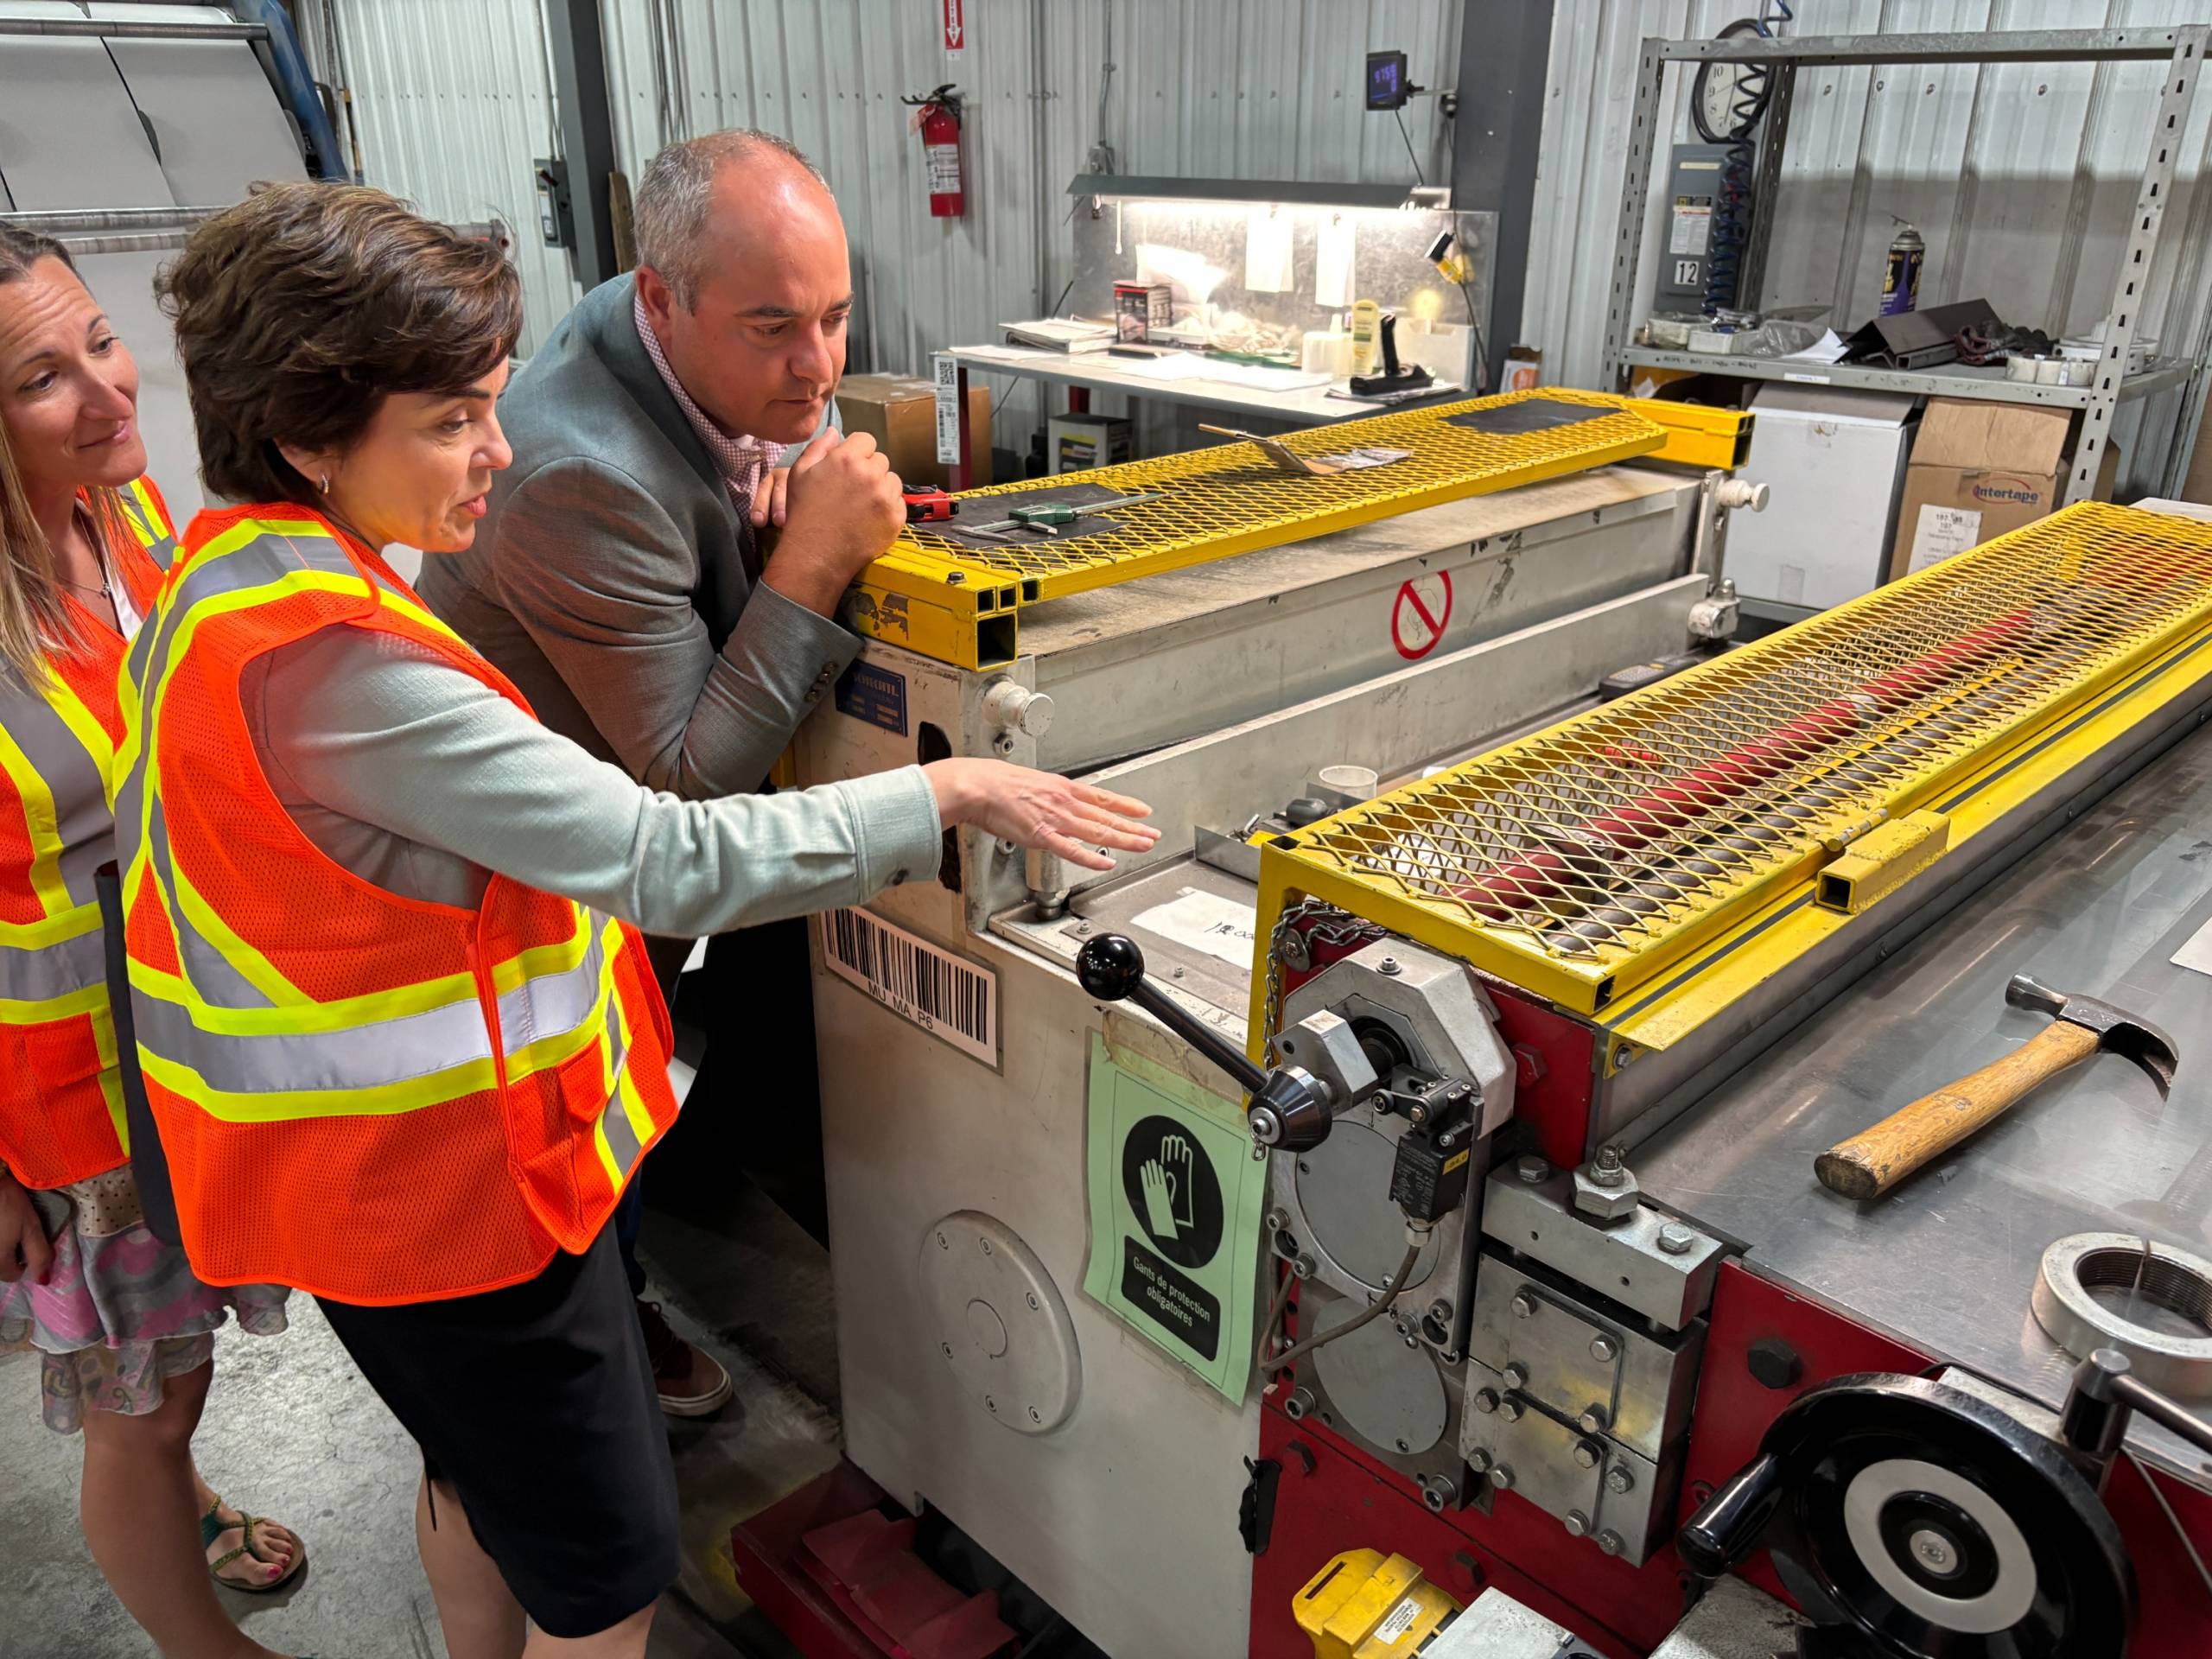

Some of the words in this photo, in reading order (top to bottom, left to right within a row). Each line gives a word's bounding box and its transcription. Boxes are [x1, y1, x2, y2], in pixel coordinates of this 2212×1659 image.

[1713, 65, 1724, 78] 10
[1708, 86, 1716, 97] 9
[1678, 262, 1698, 285] 12
[1975, 484, 2038, 504] Intertape
[868, 980, 887, 1001] MU
[893, 995, 912, 1018] MA
[1133, 1255, 1156, 1282] Gants
[1157, 1274, 1167, 1290] de
[1169, 1285, 1211, 1323] protection
[1147, 1286, 1193, 1327] obligatoires
